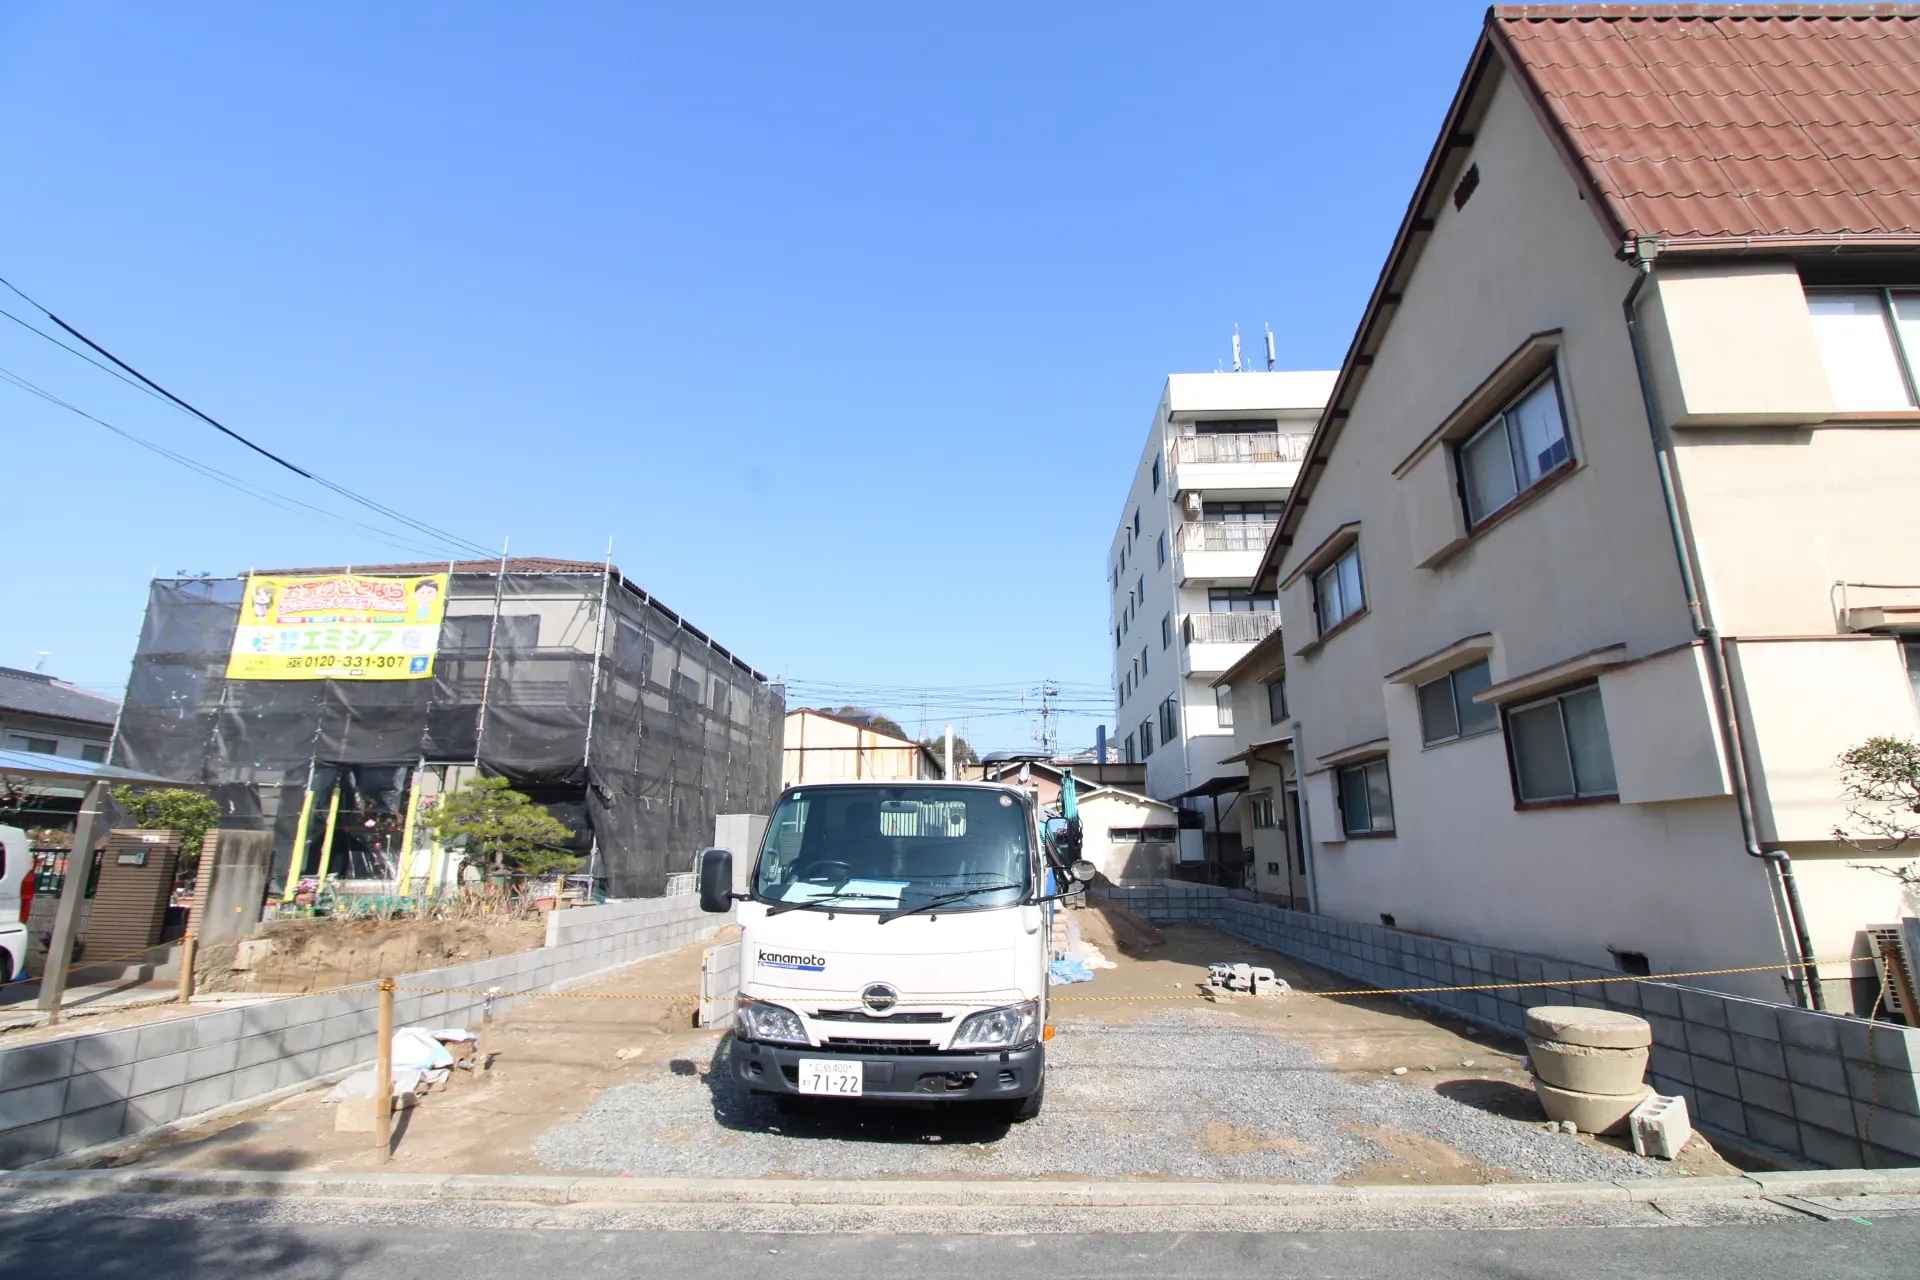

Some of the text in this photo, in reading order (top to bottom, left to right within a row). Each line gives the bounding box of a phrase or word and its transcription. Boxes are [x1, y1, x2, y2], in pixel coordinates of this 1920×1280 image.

[302, 629, 393, 651] エミシア
[759, 949, 826, 966] kanamoto
[813, 1074, 858, 1093] 71-22
